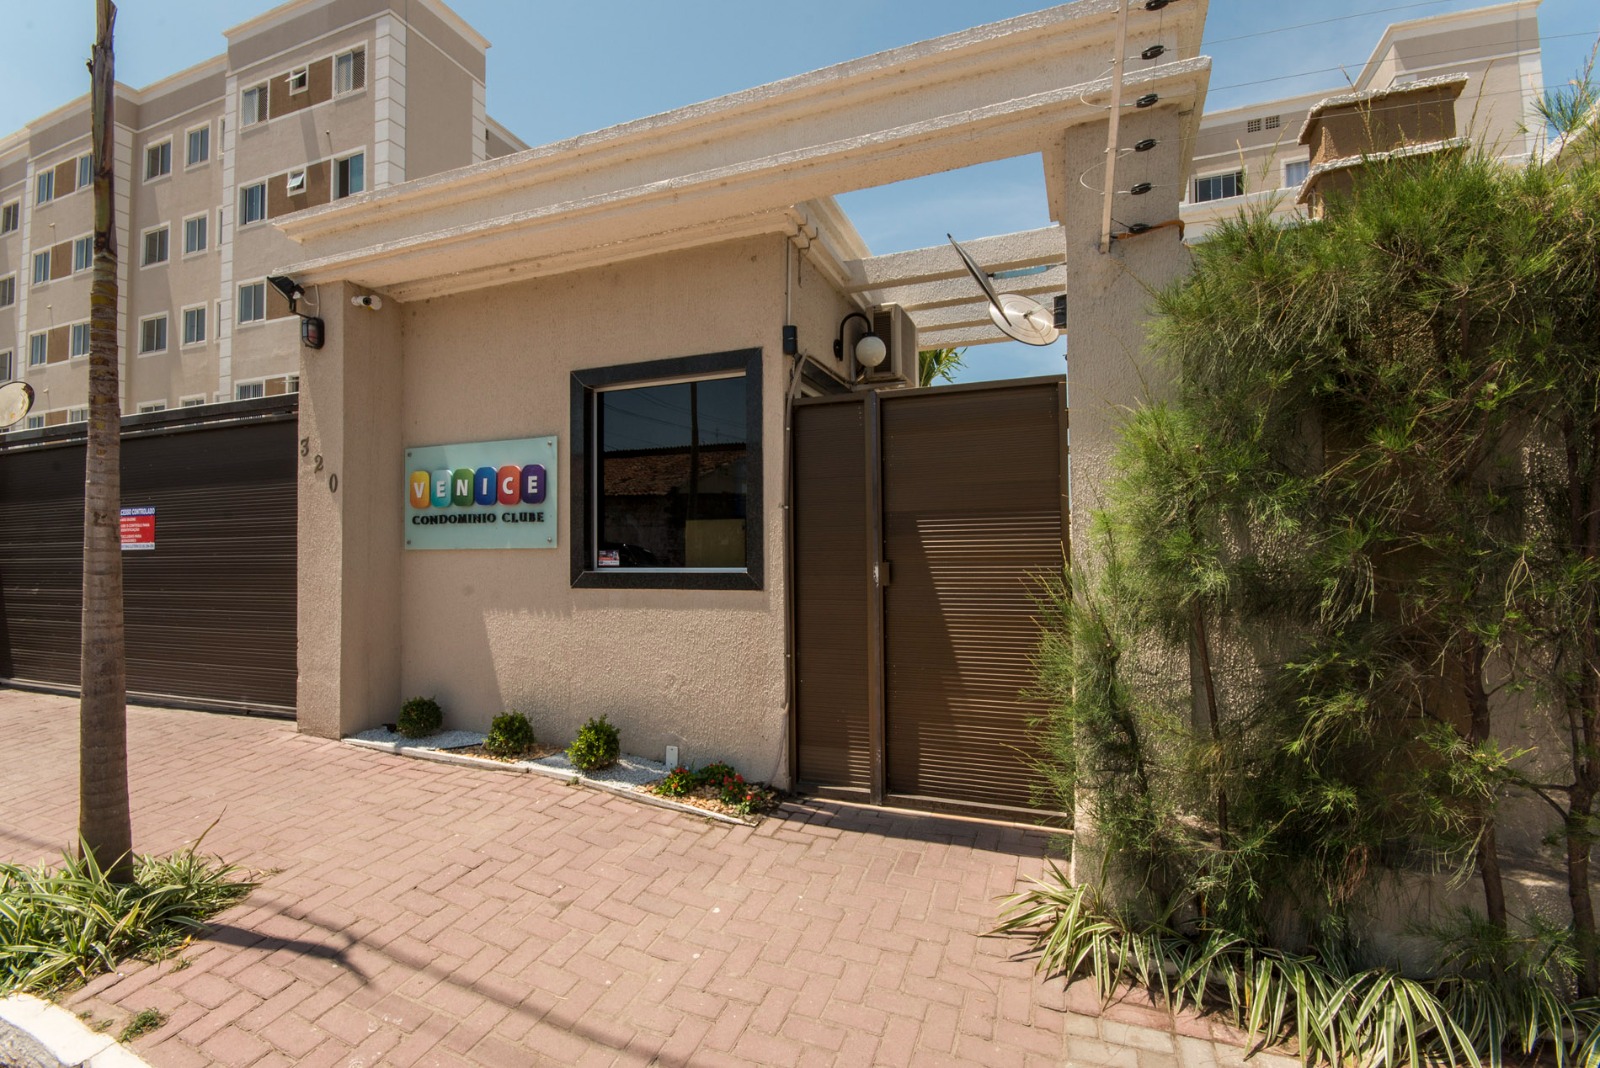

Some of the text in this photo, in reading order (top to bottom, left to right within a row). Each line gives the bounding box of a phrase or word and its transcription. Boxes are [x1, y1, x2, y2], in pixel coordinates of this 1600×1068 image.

[412, 474, 540, 499] VENICE
[412, 512, 545, 525] CONDOMINIO CLUBE
